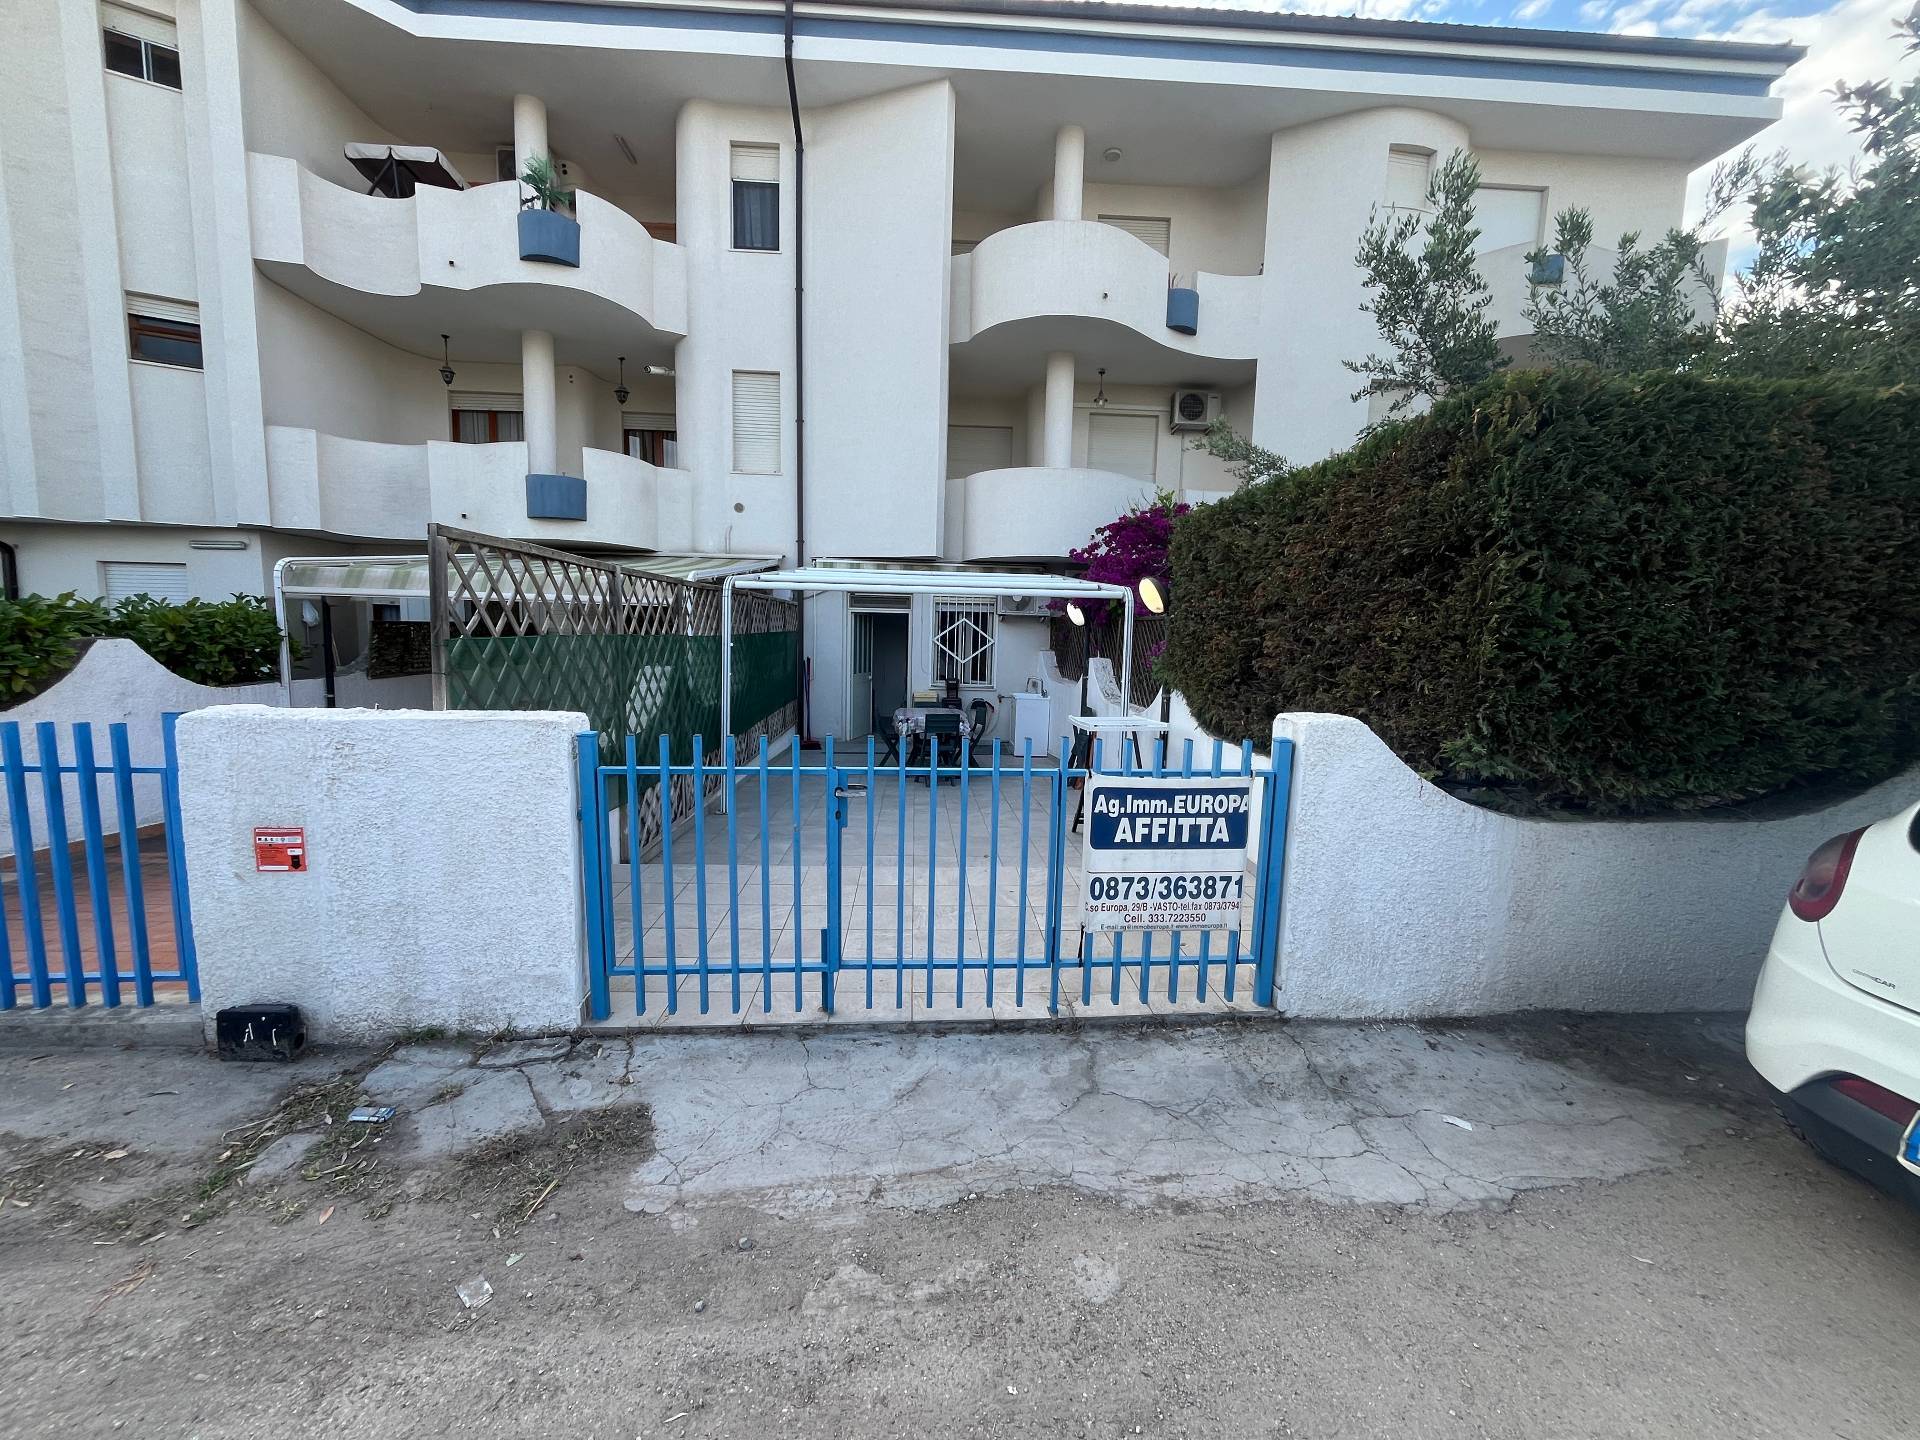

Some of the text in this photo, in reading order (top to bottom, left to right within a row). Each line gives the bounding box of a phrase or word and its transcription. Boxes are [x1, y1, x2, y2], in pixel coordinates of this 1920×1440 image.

[1114, 817, 1230, 843] AFFITTA
[1090, 875, 1243, 901] 0873/363871
[1101, 902, 1130, 913] Europa,
[1131, 902, 1148, 912] 29/B
[1204, 901, 1241, 911] 0873/3794
[1124, 913, 1206, 923] Cell. 333.7223550
